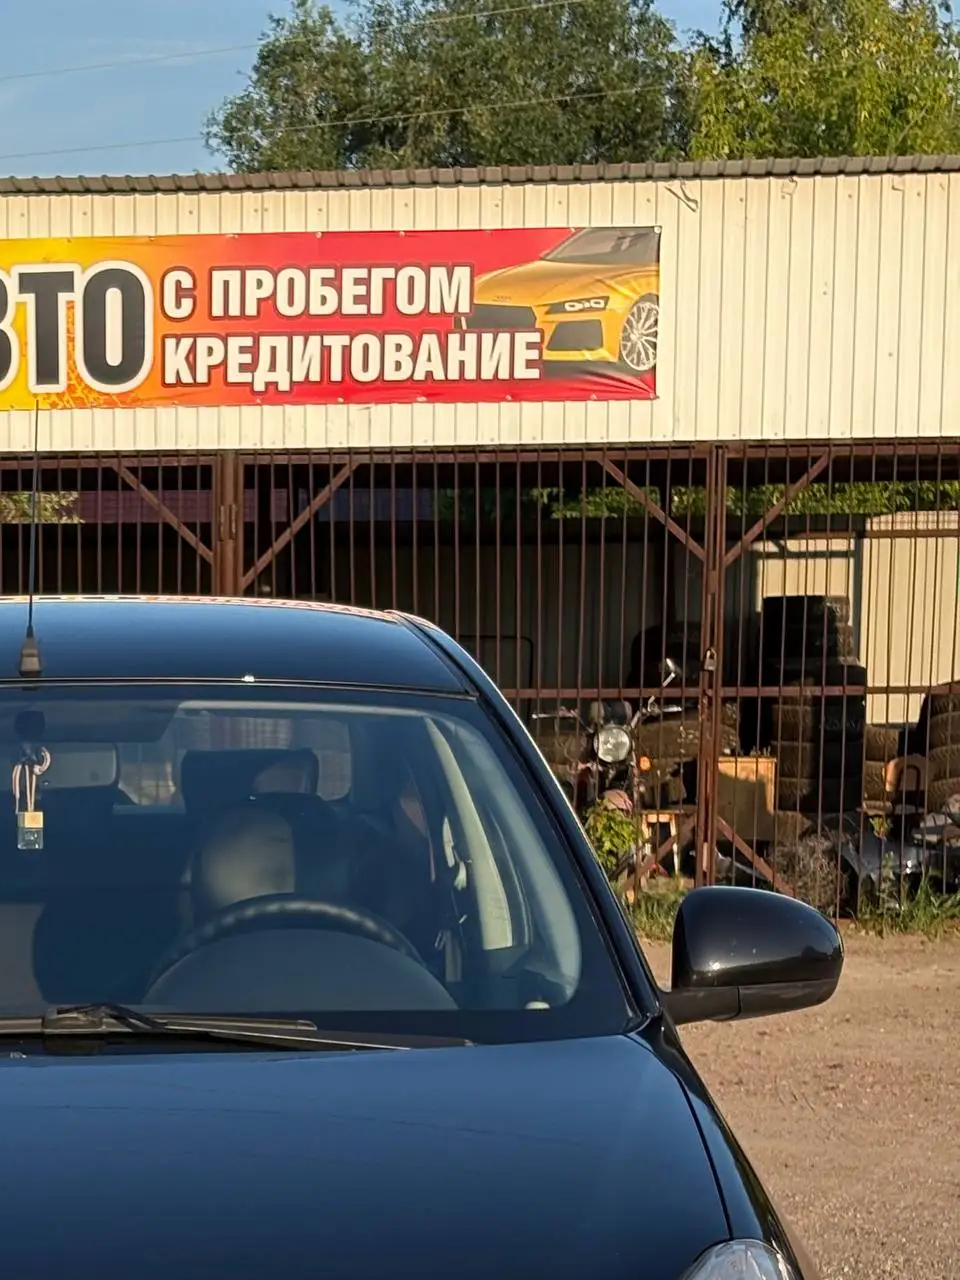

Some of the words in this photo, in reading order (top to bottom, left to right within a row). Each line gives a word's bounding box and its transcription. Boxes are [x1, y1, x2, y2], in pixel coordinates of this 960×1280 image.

[162, 268, 196, 319] С
[211, 264, 472, 317] ПРОБЕГОМ
[163, 330, 542, 393] КРЕДИТОВАНИЕ
